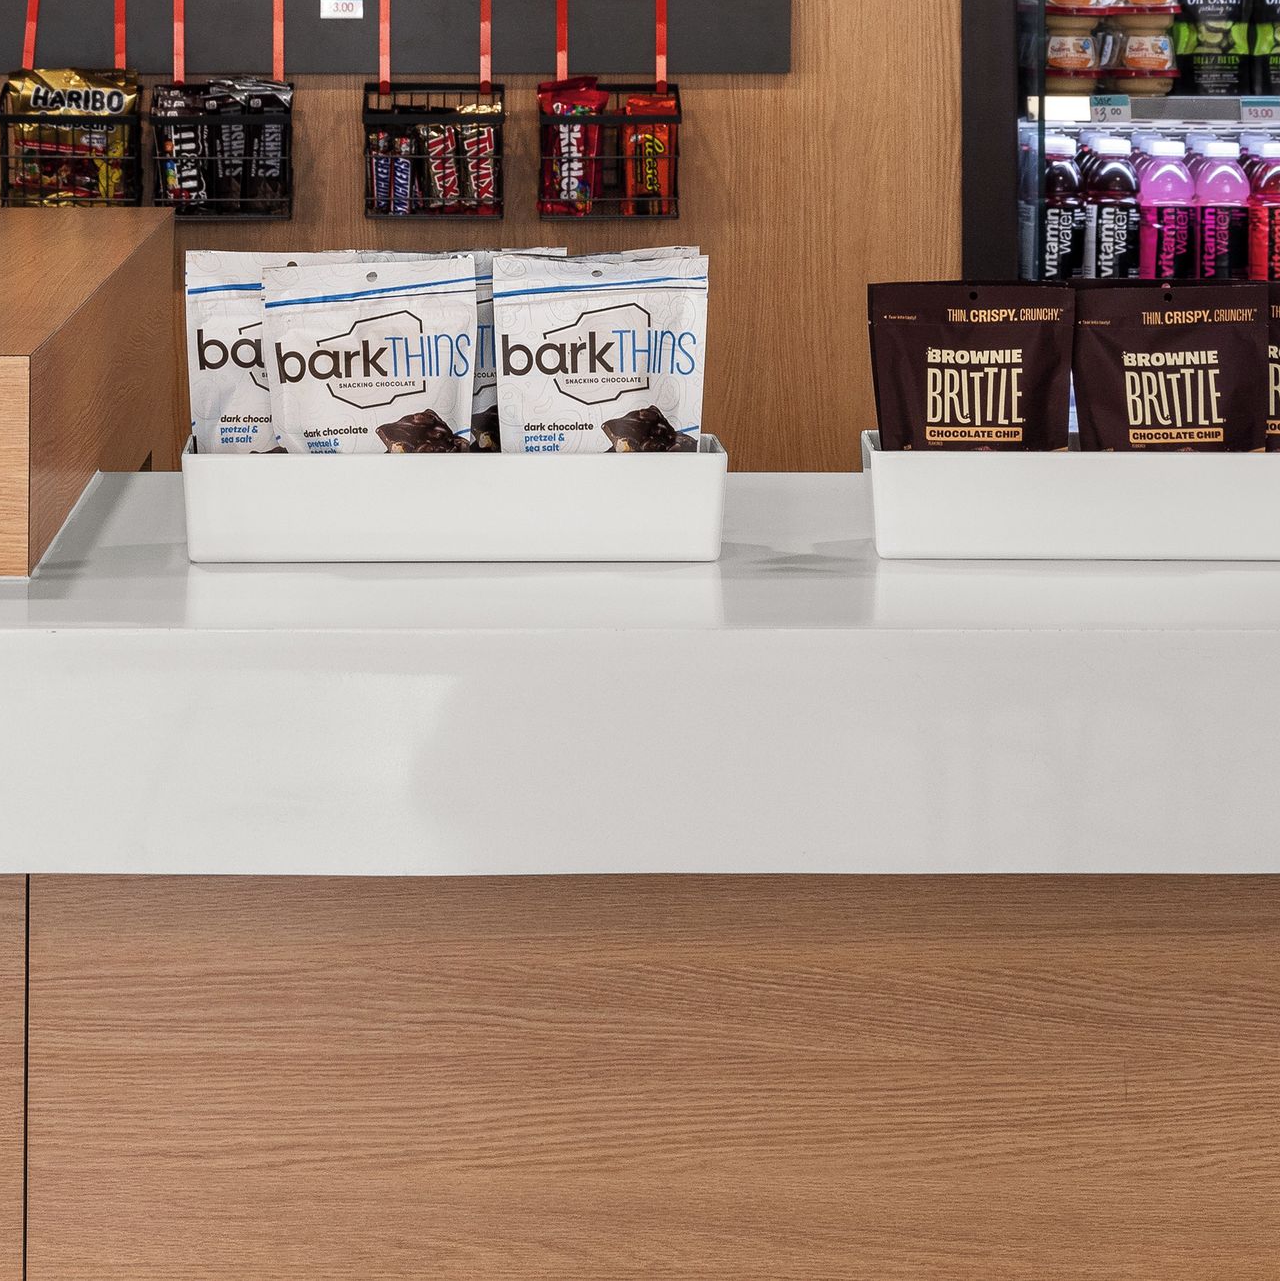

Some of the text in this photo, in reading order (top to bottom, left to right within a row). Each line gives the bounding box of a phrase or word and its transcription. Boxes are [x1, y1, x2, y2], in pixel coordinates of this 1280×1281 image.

[31, 85, 124, 114] HARIBO
[1248, 108, 1273, 118] $3.00
[429, 126, 460, 199] TWIX
[464, 127, 495, 199] TWIX
[1060, 209, 1072, 255] water
[1114, 208, 1127, 255] water
[1045, 208, 1059, 277] vitamin
[1098, 207, 1114, 277] vitamin
[947, 308, 969, 322] THIN.
[970, 309, 1018, 322] CRISPY.
[1142, 311, 1164, 325] THIN.
[1164, 310, 1212, 324] CRISPY.
[926, 348, 1023, 364] BROWNIE
[1123, 350, 1219, 366] BROWNIE
[339, 381, 374, 389] SNACKING
[601, 376, 641, 384] CHOCOLATE
[927, 367, 1023, 426] BRITTLE
[1125, 368, 1224, 427] BRITTLE
[220, 415, 272, 423] dark chocol
[220, 425, 258, 436] pretzel &
[304, 426, 369, 438] dark chocolate
[524, 421, 594, 432] dark chocolate
[236, 434, 252, 443] salt
[524, 433, 565, 444] pretzel &
[929, 429, 1020, 438] CHOCOLATE CHIP
[1132, 430, 1221, 440] CHOCOLATE CHIP
[307, 439, 339, 449] pretzel &
[525, 443, 560, 452] sea salt
